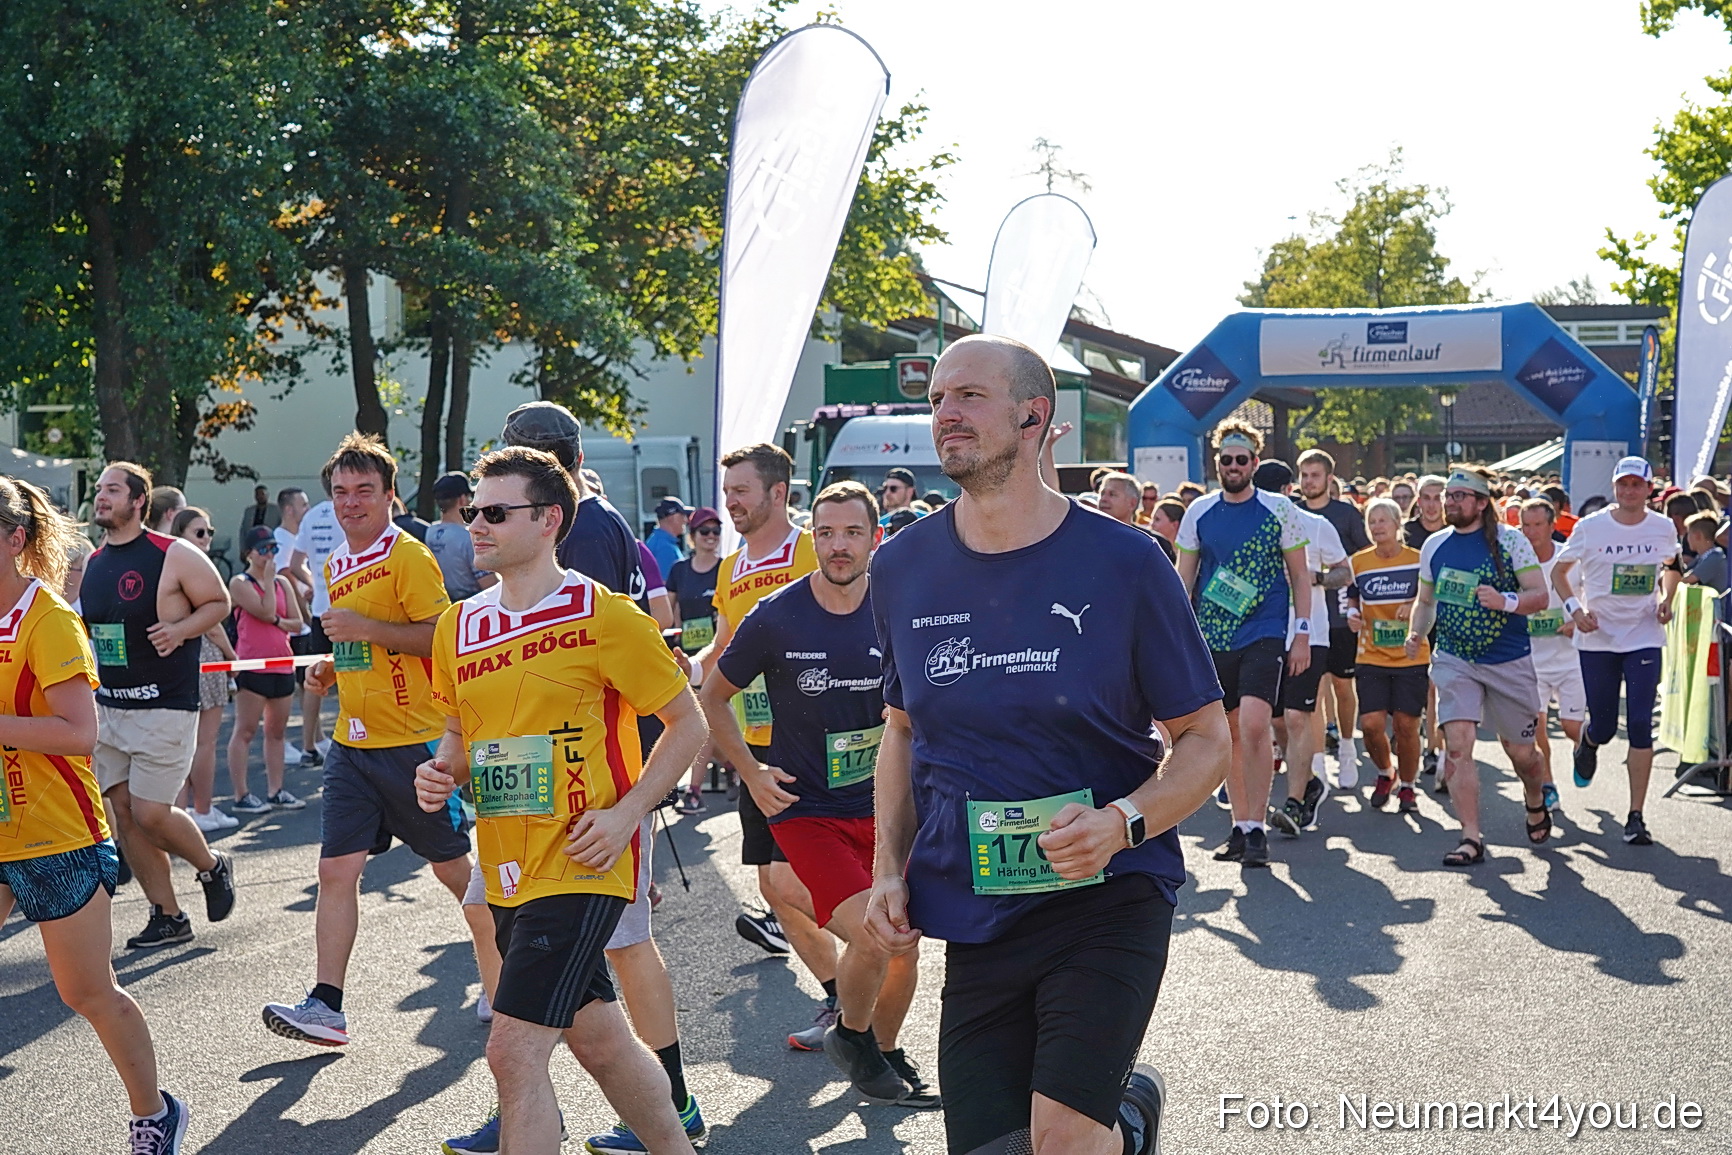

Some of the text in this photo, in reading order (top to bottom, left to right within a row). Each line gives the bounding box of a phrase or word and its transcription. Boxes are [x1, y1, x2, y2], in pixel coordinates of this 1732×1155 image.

[1353, 343, 1442, 362] firmenlauf
[1605, 545, 1652, 554] APTIV
[329, 565, 391, 606] MAX BÖGL
[729, 572, 794, 600] MAX BÖGL
[1373, 581, 1411, 592] Fischer
[1444, 580, 1465, 594] 693
[1623, 575, 1646, 586] 234
[1219, 583, 1241, 601] 694
[920, 613, 971, 628] PFLEIDERER
[457, 628, 597, 686] MAX BÖGL
[793, 652, 827, 660] PFLEIDERER
[972, 648, 1060, 670] Firmenlauf
[1005, 661, 1057, 675] neumarkt
[828, 676, 883, 688] Firmenlauf
[112, 683, 160, 700] FITNESS
[746, 692, 768, 710] 619
[832, 758, 840, 778] RUN
[481, 763, 532, 792] 1651
[537, 767, 548, 803] 2022
[474, 776, 482, 803] RUN
[503, 791, 538, 803] Raphael
[1000, 815, 1040, 827] Firmenlauf
[977, 844, 991, 876] RUN
[997, 867, 1036, 878] Häring
